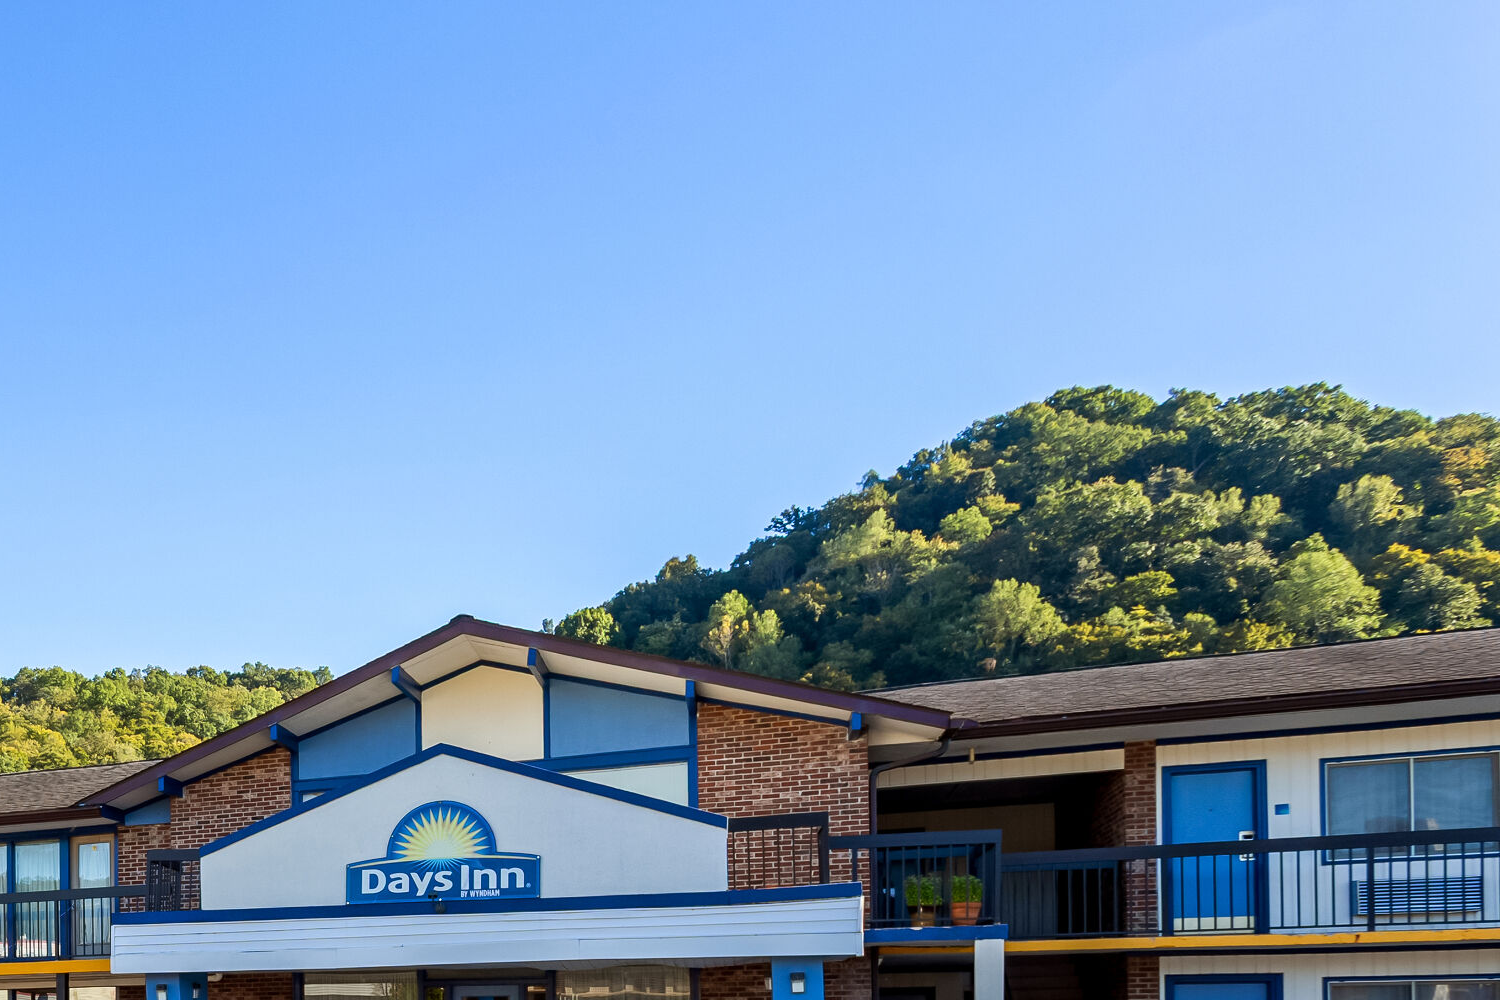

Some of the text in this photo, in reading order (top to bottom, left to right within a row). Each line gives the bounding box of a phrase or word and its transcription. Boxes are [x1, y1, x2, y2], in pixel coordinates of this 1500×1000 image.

[361, 869, 454, 897] Days
[460, 889, 500, 898] BY WYNDHAM
